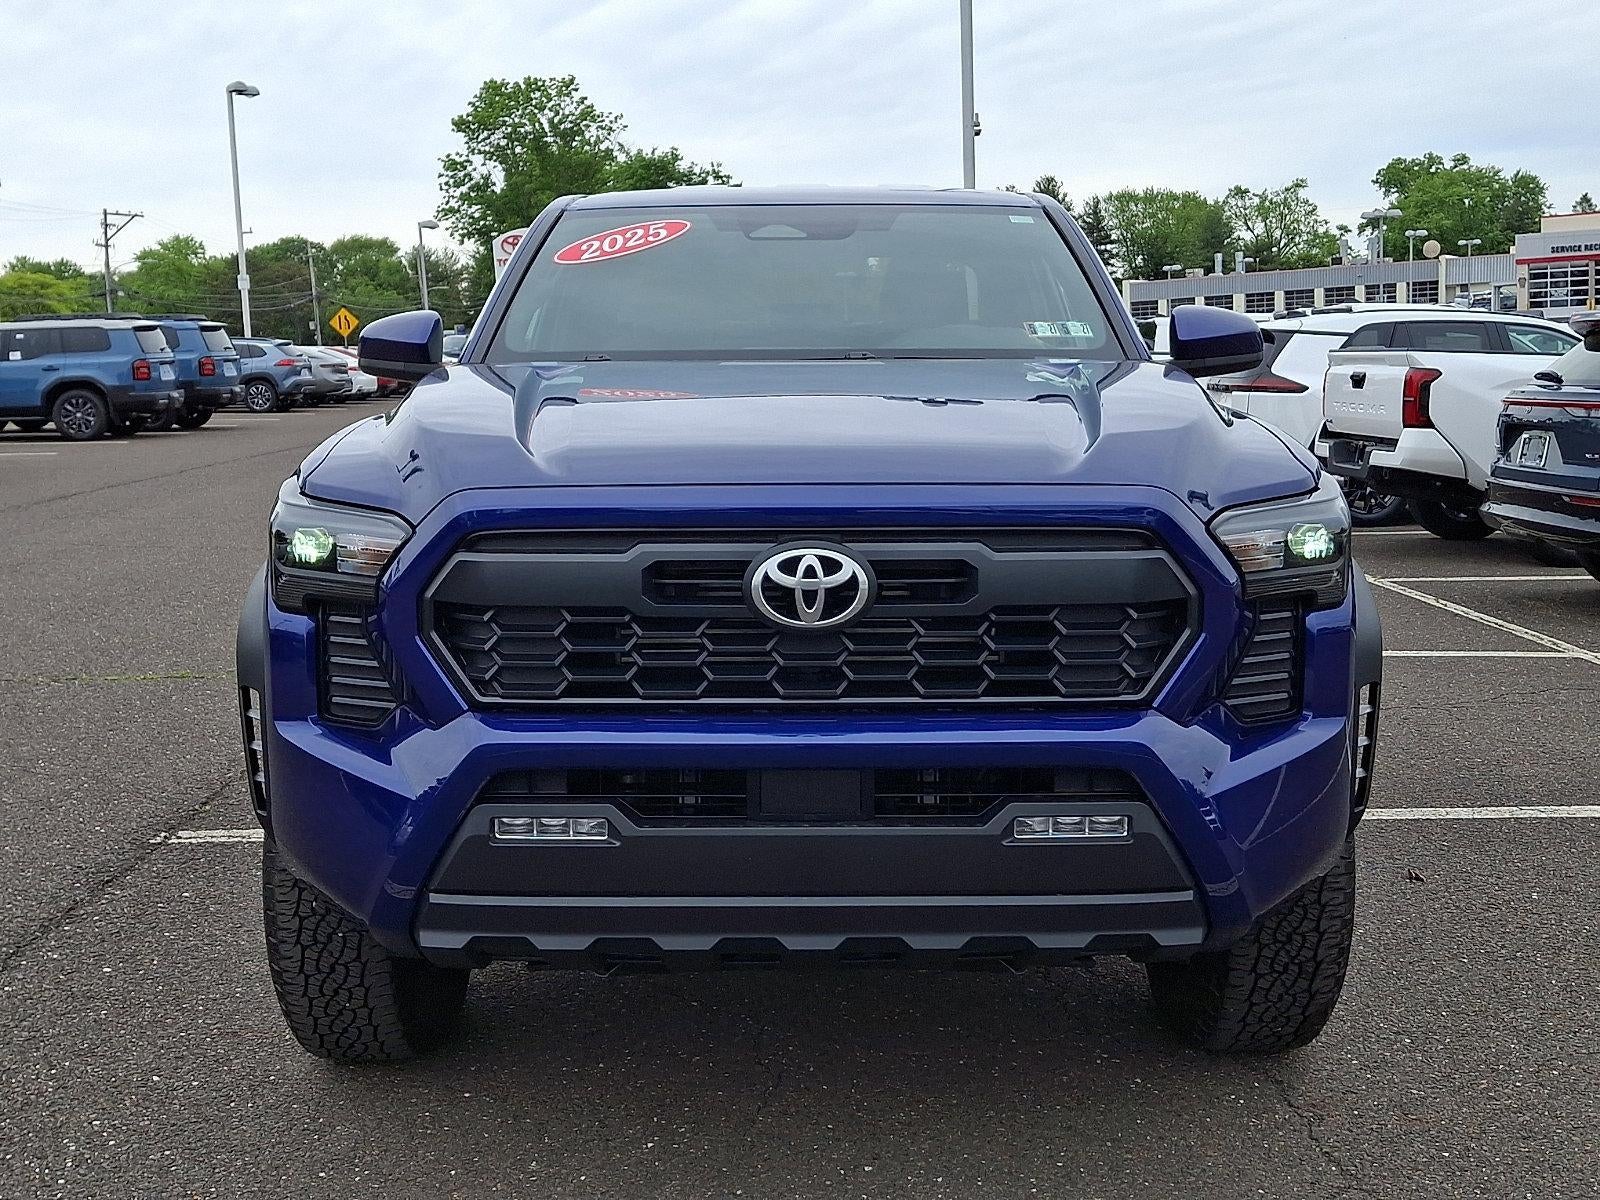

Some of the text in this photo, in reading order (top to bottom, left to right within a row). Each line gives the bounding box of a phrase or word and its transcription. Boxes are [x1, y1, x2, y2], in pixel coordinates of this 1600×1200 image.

[580, 223, 667, 260] 2025
[1550, 243, 1600, 254] SERVICE REC
[1333, 401, 1386, 415] TACOMA
